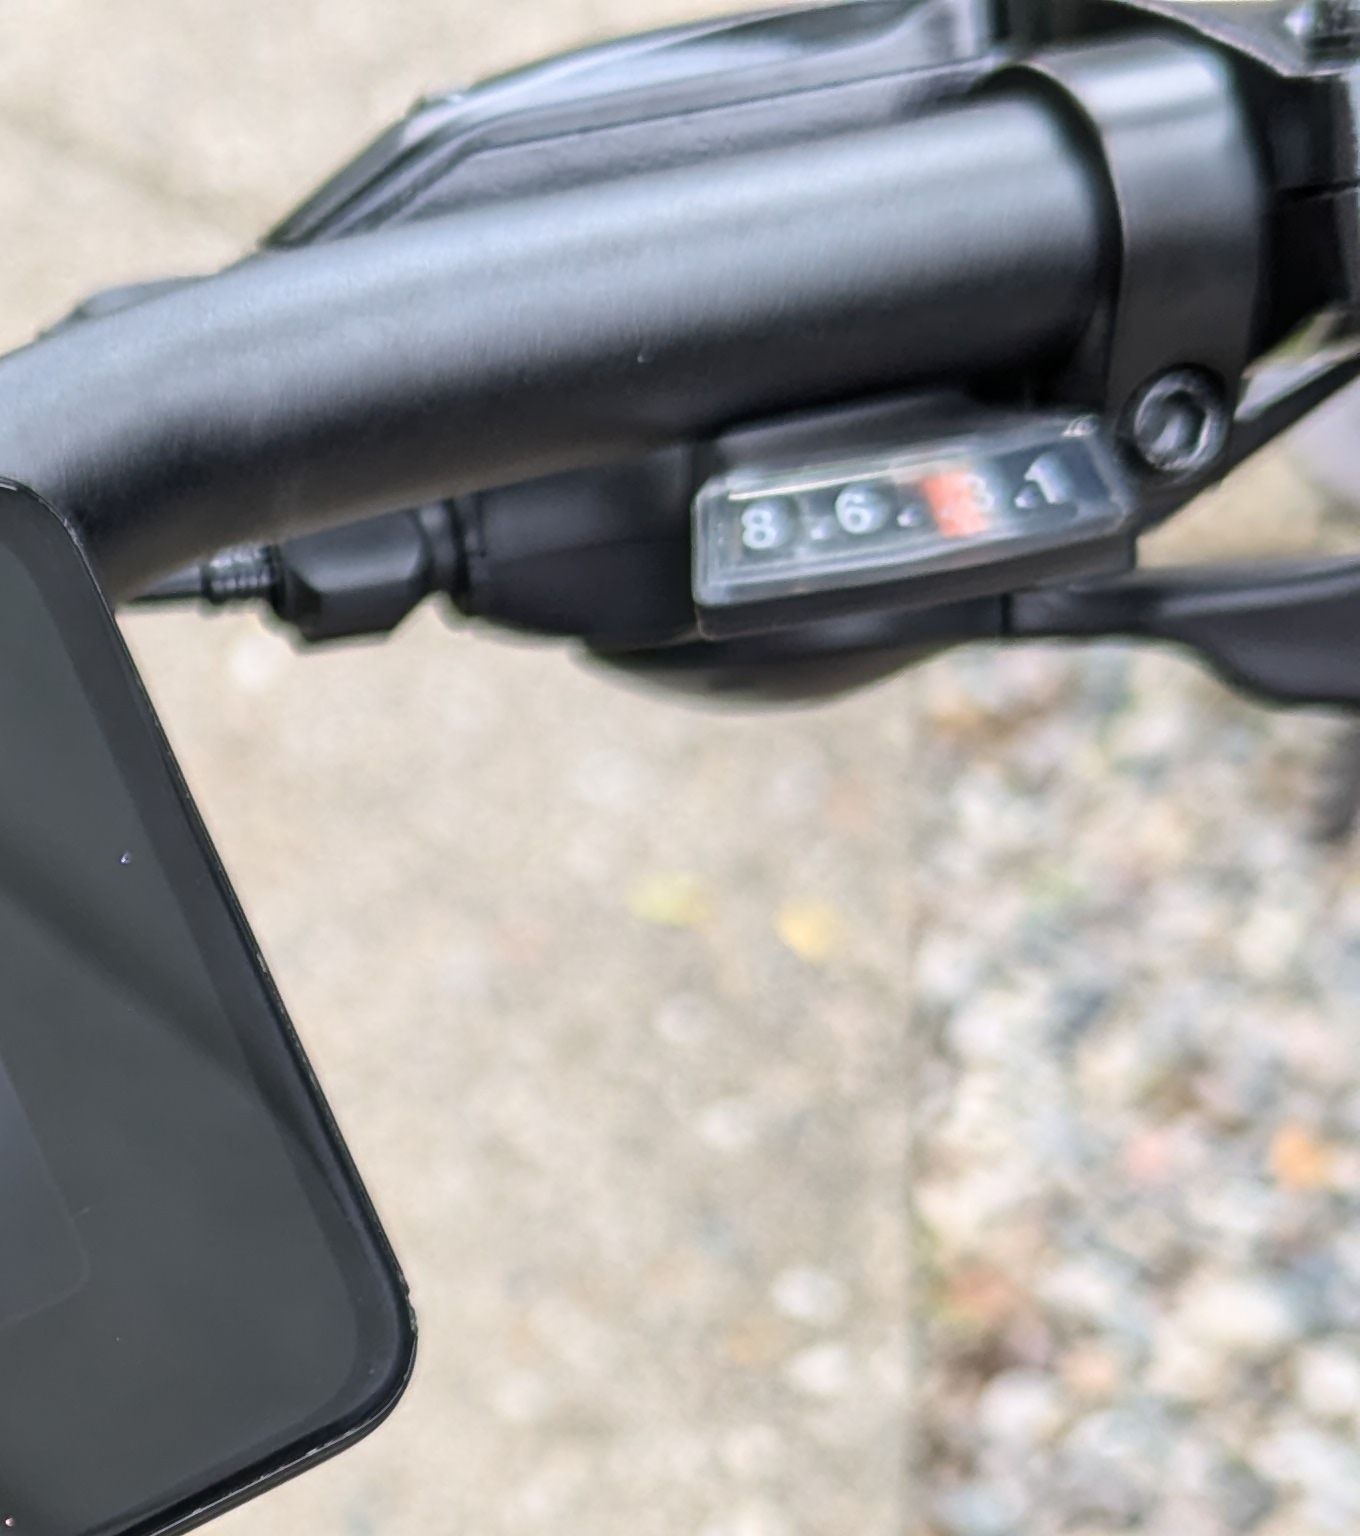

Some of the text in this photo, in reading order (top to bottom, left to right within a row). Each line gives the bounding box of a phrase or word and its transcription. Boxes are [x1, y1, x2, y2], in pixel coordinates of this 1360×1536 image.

[739, 505, 780, 551] 8
[834, 485, 873, 535] 6
[1023, 454, 1067, 505] 1
